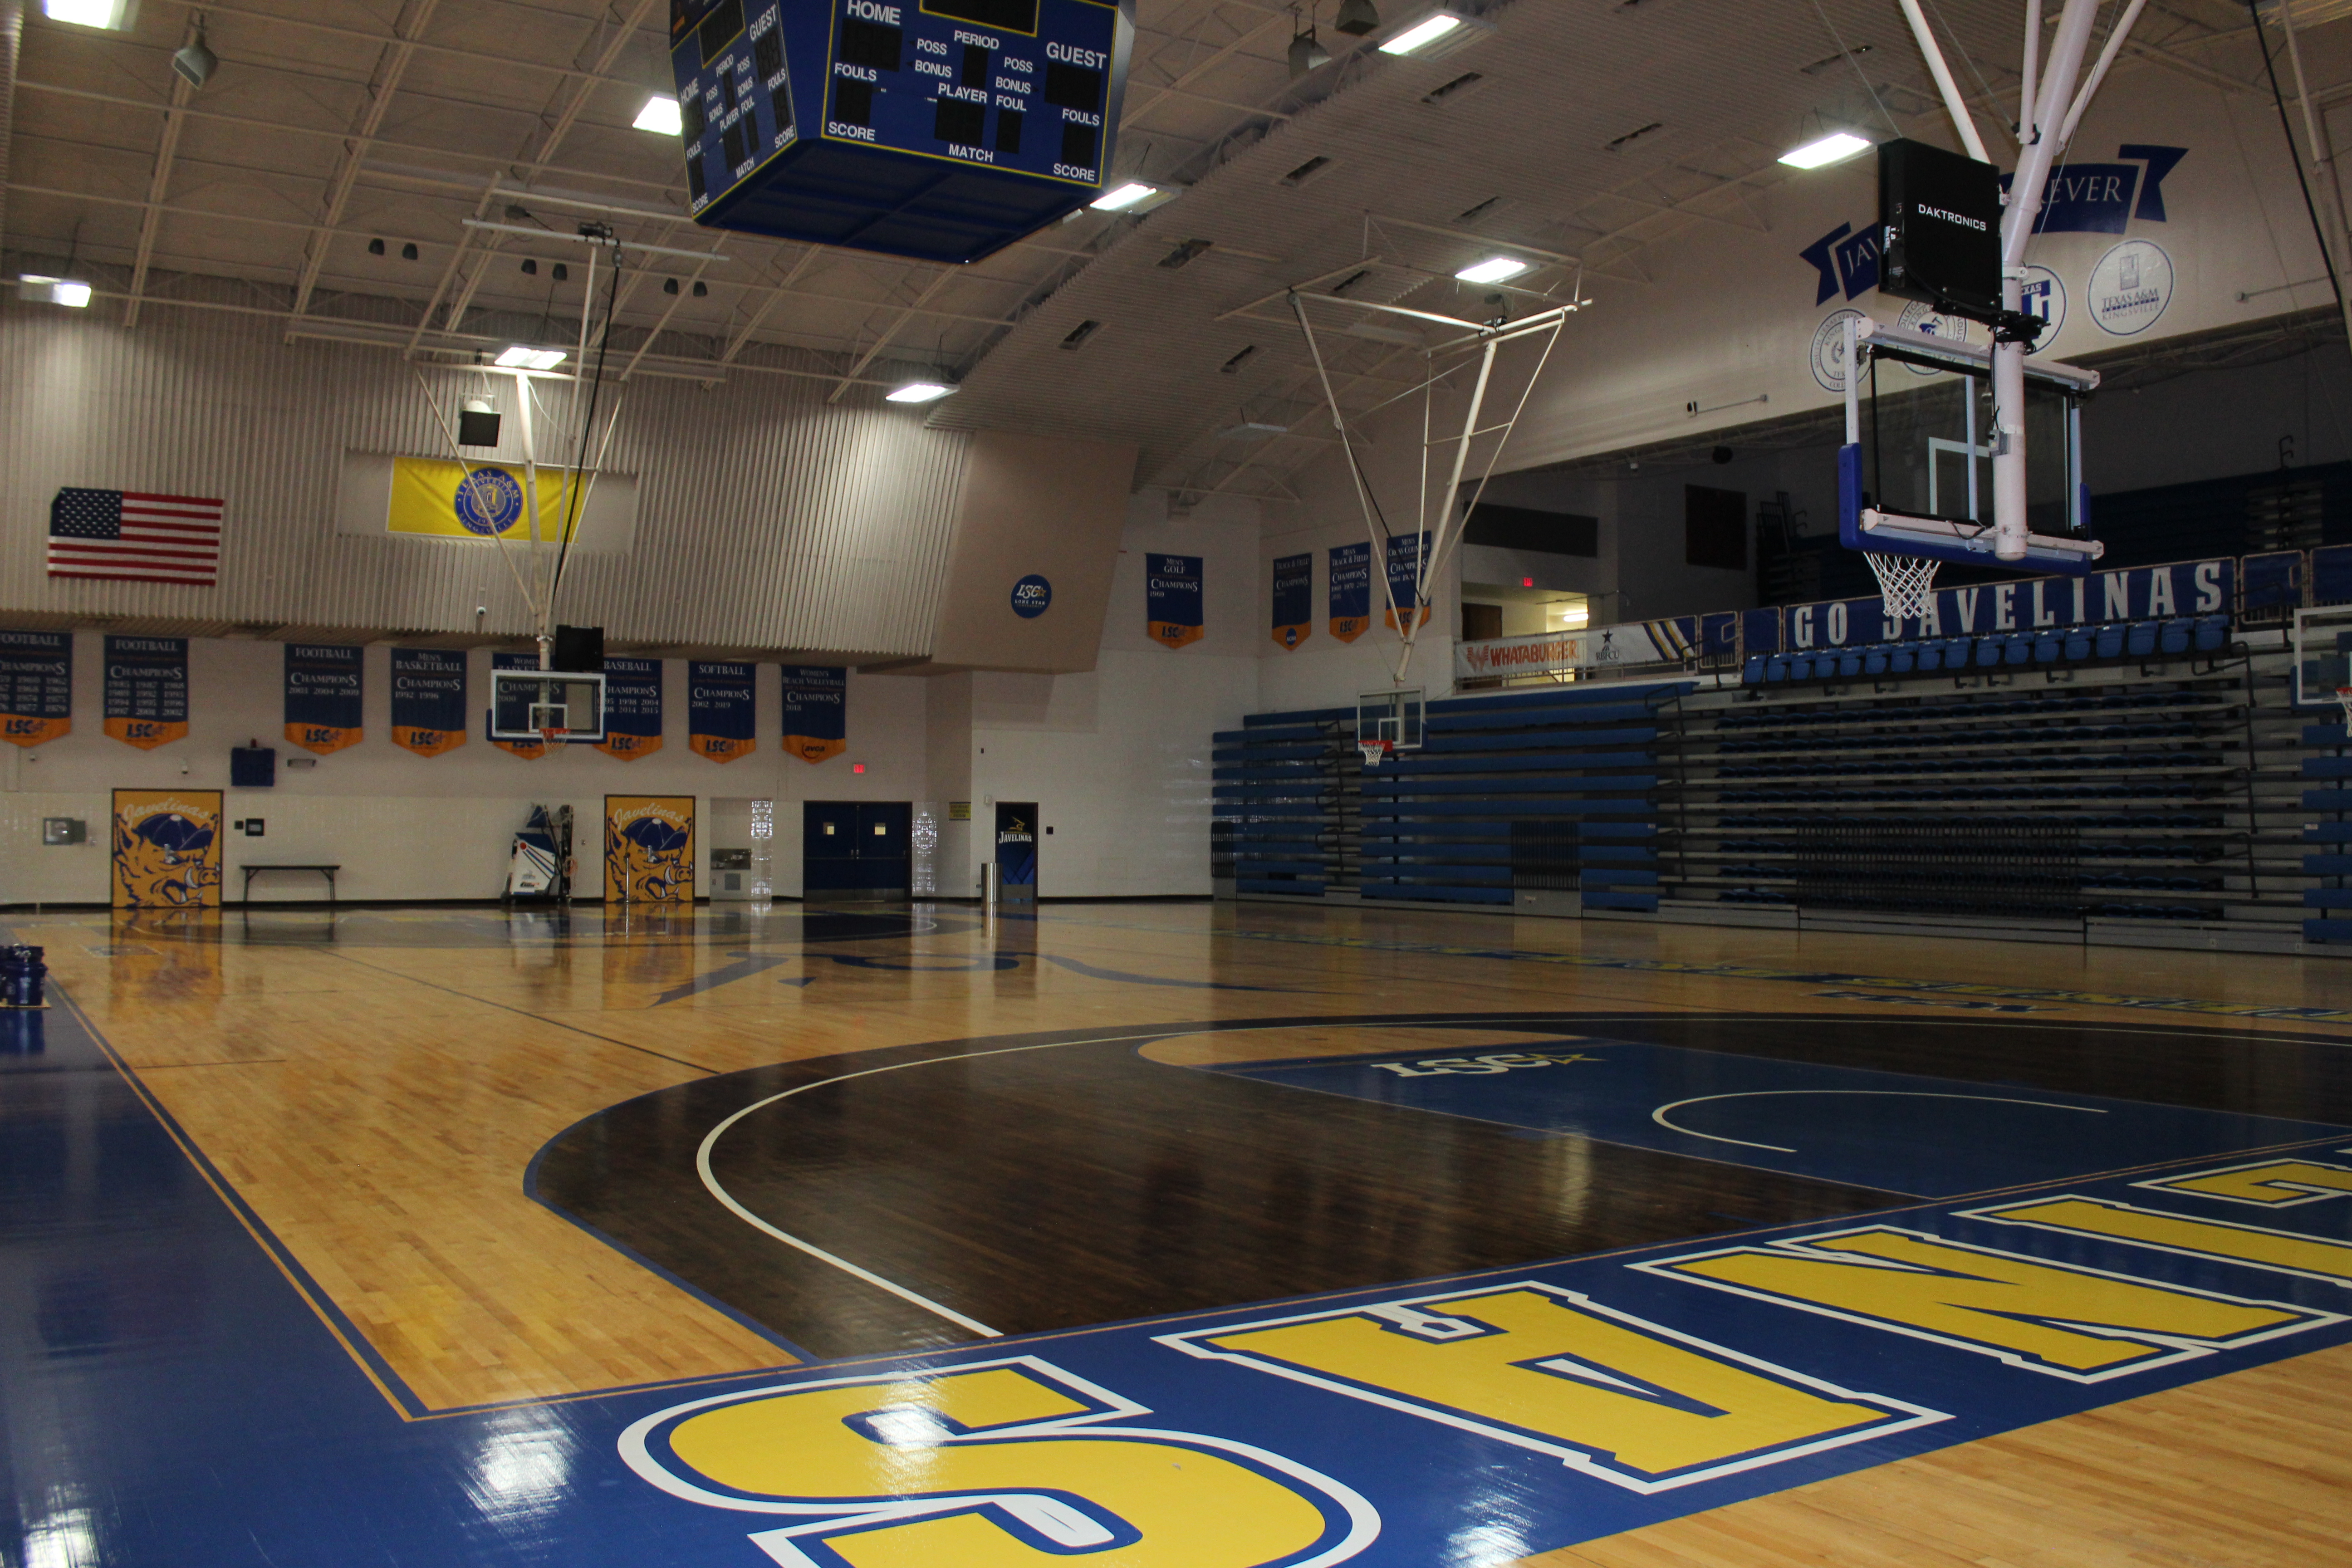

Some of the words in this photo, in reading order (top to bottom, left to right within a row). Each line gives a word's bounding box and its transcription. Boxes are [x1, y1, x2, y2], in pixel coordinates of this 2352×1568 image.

[848, 0, 901, 25] HOME
[750, 4, 776, 41] GUEST
[917, 38, 947, 55] POSS
[954, 30, 999, 49] PERIOD
[1046, 42, 1107, 69] GUEST
[716, 54, 733, 77] PERIOD
[737, 56, 750, 74] POSS
[834, 62, 877, 81] FOULS
[915, 59, 952, 78] BONUS
[1004, 57, 1033, 73] POSS
[737, 76, 753, 97] BONUS
[768, 68, 786, 91] FOULS
[996, 76, 1031, 94] BONUS
[681, 78, 699, 106] HOME
[706, 85, 718, 103] POSS
[938, 83, 987, 104] PLAYER
[996, 95, 1026, 111] FOUL
[709, 103, 723, 122] BONUS
[720, 108, 739, 132] PLAYER
[741, 95, 755, 113] FOUL
[1063, 108, 1099, 126] FOULS
[775, 125, 794, 148] SCORE
[828, 122, 875, 141] SCORE
[686, 141, 701, 160] FOULS
[949, 143, 993, 162] MATCH
[736, 157, 754, 179] MATCH
[1054, 163, 1095, 181] SCORE
[2041, 176, 2122, 204] EVER
[692, 192, 708, 213] SCORE
[1918, 204, 1986, 230] DAKTRONICS
[2102, 290, 2133, 309] TEXAS
[2133, 287, 2158, 300] A&M
[2103, 303, 2159, 320] KINGSVILLE
[466, 479, 511, 498] UIVERSITY
[499, 474, 520, 499] A&M
[459, 513, 514, 534] KINGSVLLE
[1405, 544, 1429, 553] COUNRY
[1332, 557, 1347, 567] TRACK
[1354, 554, 1368, 563] FIELD
[1164, 565, 1186, 574] GOLF
[1332, 568, 1367, 584] CHAMPIONS
[1017, 584, 1041, 599] LSC
[1151, 578, 1198, 592] CHAMPIONS
[1276, 575, 1308, 591] CHAMPIONS
[1794, 602, 1848, 647] GO
[1883, 562, 2222, 640] JAVELINAS
[0, 633, 60, 646] OOTBALL
[1161, 625, 1179, 638] LSC
[115, 639, 178, 652] FOOTBALL
[295, 647, 353, 659] FOOTBALL
[1490, 640, 1579, 667] WHATABURGER
[418, 652, 441, 662] MEN'S
[513, 657, 540, 665] WOMEN
[1596, 648, 1620, 661] RBFCU
[0, 662, 66, 676] HAMPIONS
[110, 665, 183, 680] CHAMPIONS
[396, 660, 462, 671] BASKETBALL
[604, 661, 652, 671] BASEBALL
[699, 665, 745, 675] SOFTBALL
[800, 668, 829, 677] WOMEN'S
[290, 672, 357, 686] CHAMPIONS
[397, 676, 461, 691] CHAMPIONS
[500, 681, 560, 694] CHAMPS
[783, 676, 804, 684] BEACH
[806, 677, 845, 686] VOLLEYBALL
[694, 687, 750, 700] CHAMPIONS
[787, 691, 840, 703] CHAMPIONS
[127, 723, 153, 738] LSC
[306, 729, 330, 743] LSC
[410, 731, 434, 745] LSC
[612, 737, 632, 750] LSC
[706, 740, 726, 752] LSC
[123, 797, 209, 828] Javelinas
[614, 802, 684, 831] Javelinas
[999, 831, 1032, 843] JAVELINAS
[1370, 1054, 1552, 1078] LSC
